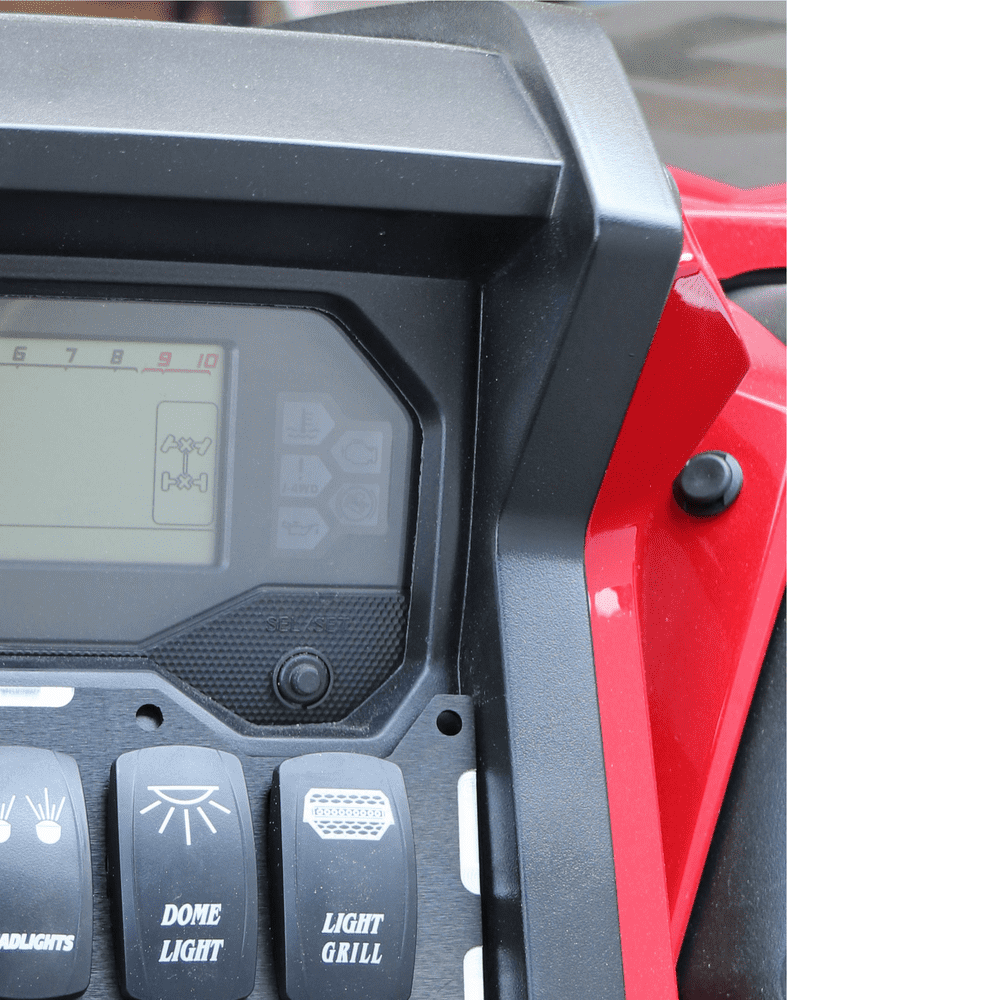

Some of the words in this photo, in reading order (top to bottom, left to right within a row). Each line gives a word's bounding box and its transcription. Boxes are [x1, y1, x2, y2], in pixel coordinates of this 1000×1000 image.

[12, 346, 27, 361] 6
[65, 347, 78, 363] 7
[110, 349, 124, 365] 8
[157, 351, 172, 367] 9
[197, 353, 219, 369] 10
[265, 615, 350, 633] SEL/SET
[160, 902, 222, 927] DOME
[321, 912, 385, 935] LIGHT
[158, 938, 225, 963] LIGHT
[321, 941, 383, 965] GRILL
